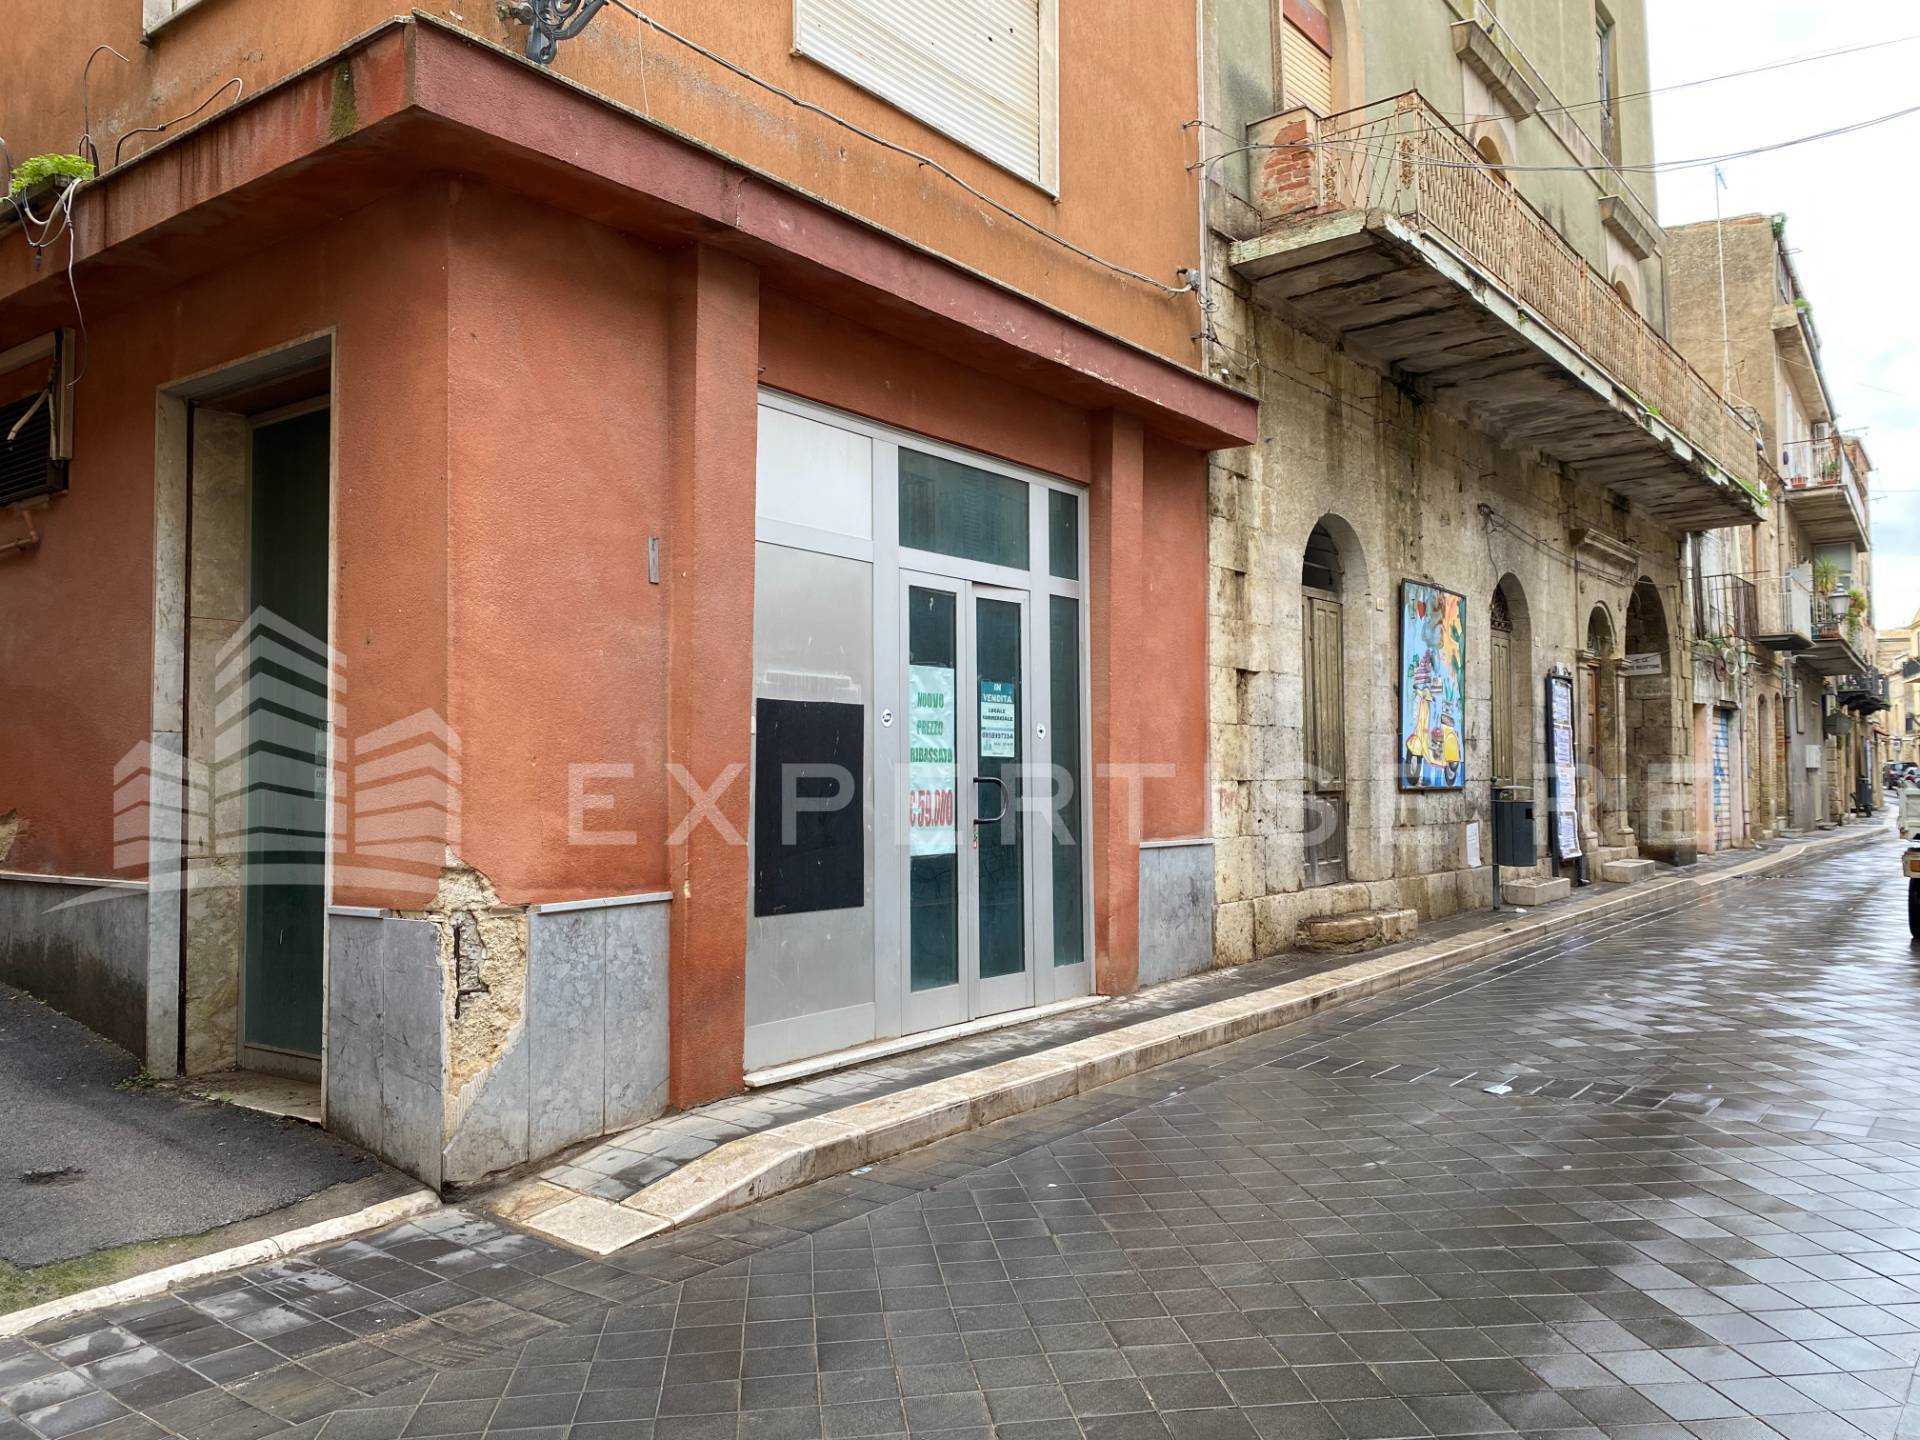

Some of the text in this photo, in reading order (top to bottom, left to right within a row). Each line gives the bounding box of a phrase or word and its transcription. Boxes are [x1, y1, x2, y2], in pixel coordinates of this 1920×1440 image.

[992, 683, 1001, 691] IN
[917, 692, 944, 708] NUOVO
[983, 693, 1012, 703] VENDITA
[917, 720, 944, 735] PREZZO
[910, 747, 952, 763] RIBASSATO
